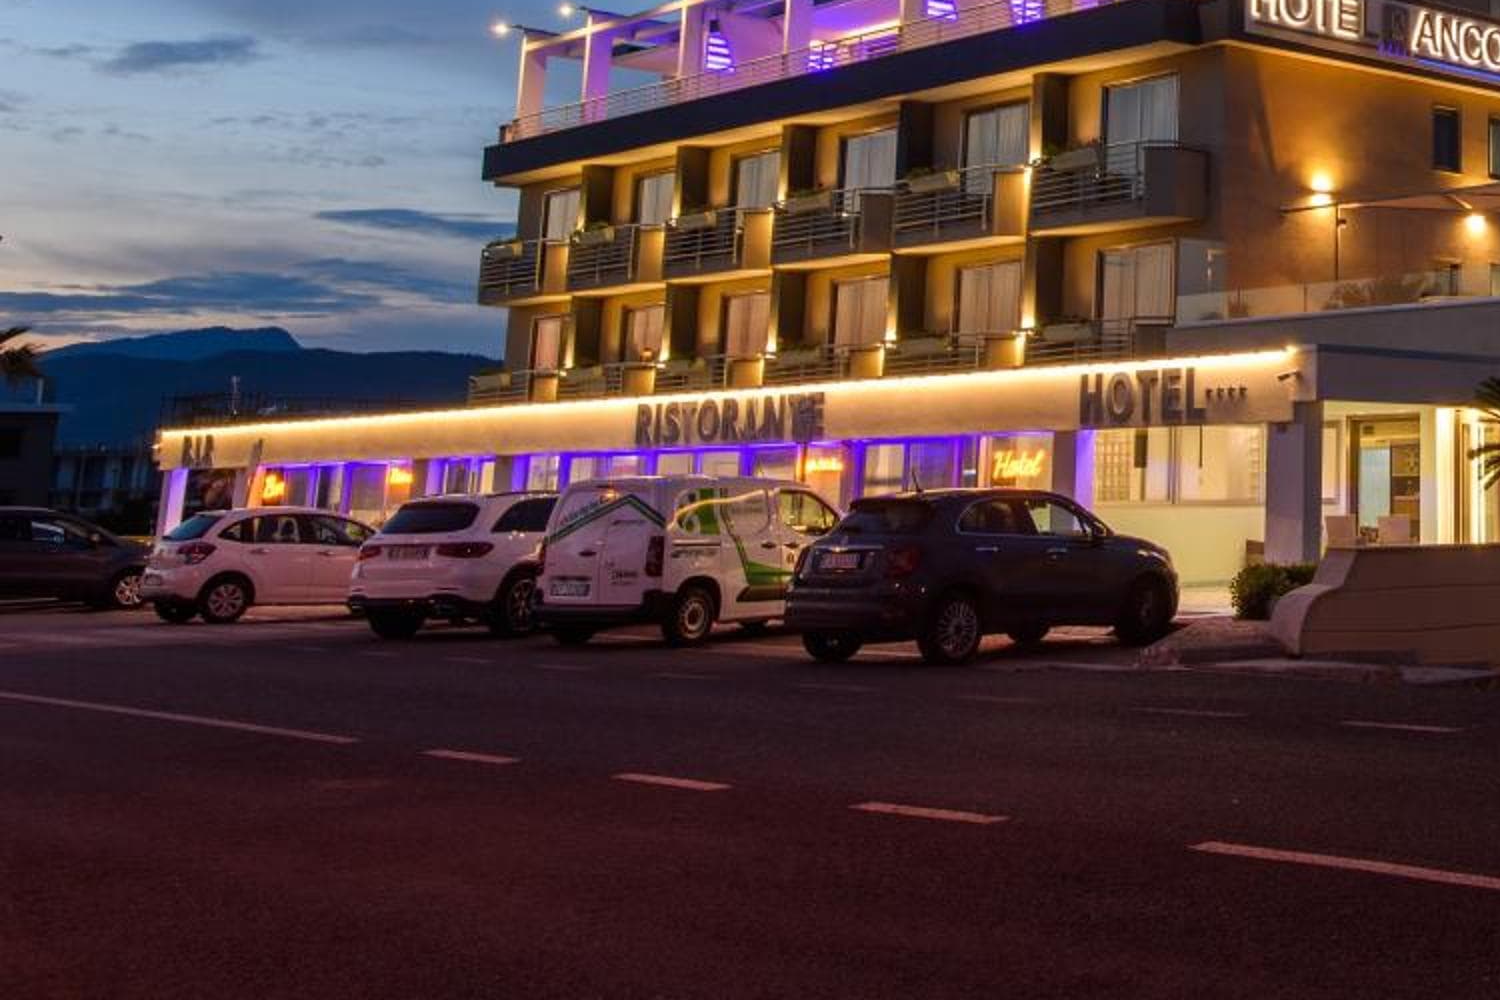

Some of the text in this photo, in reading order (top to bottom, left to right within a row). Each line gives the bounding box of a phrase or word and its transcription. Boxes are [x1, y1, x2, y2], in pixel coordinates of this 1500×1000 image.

[635, 391, 825, 446] RISTORANTE
[1079, 367, 1206, 425] HOTEL
[992, 449, 1045, 479] Hotel
